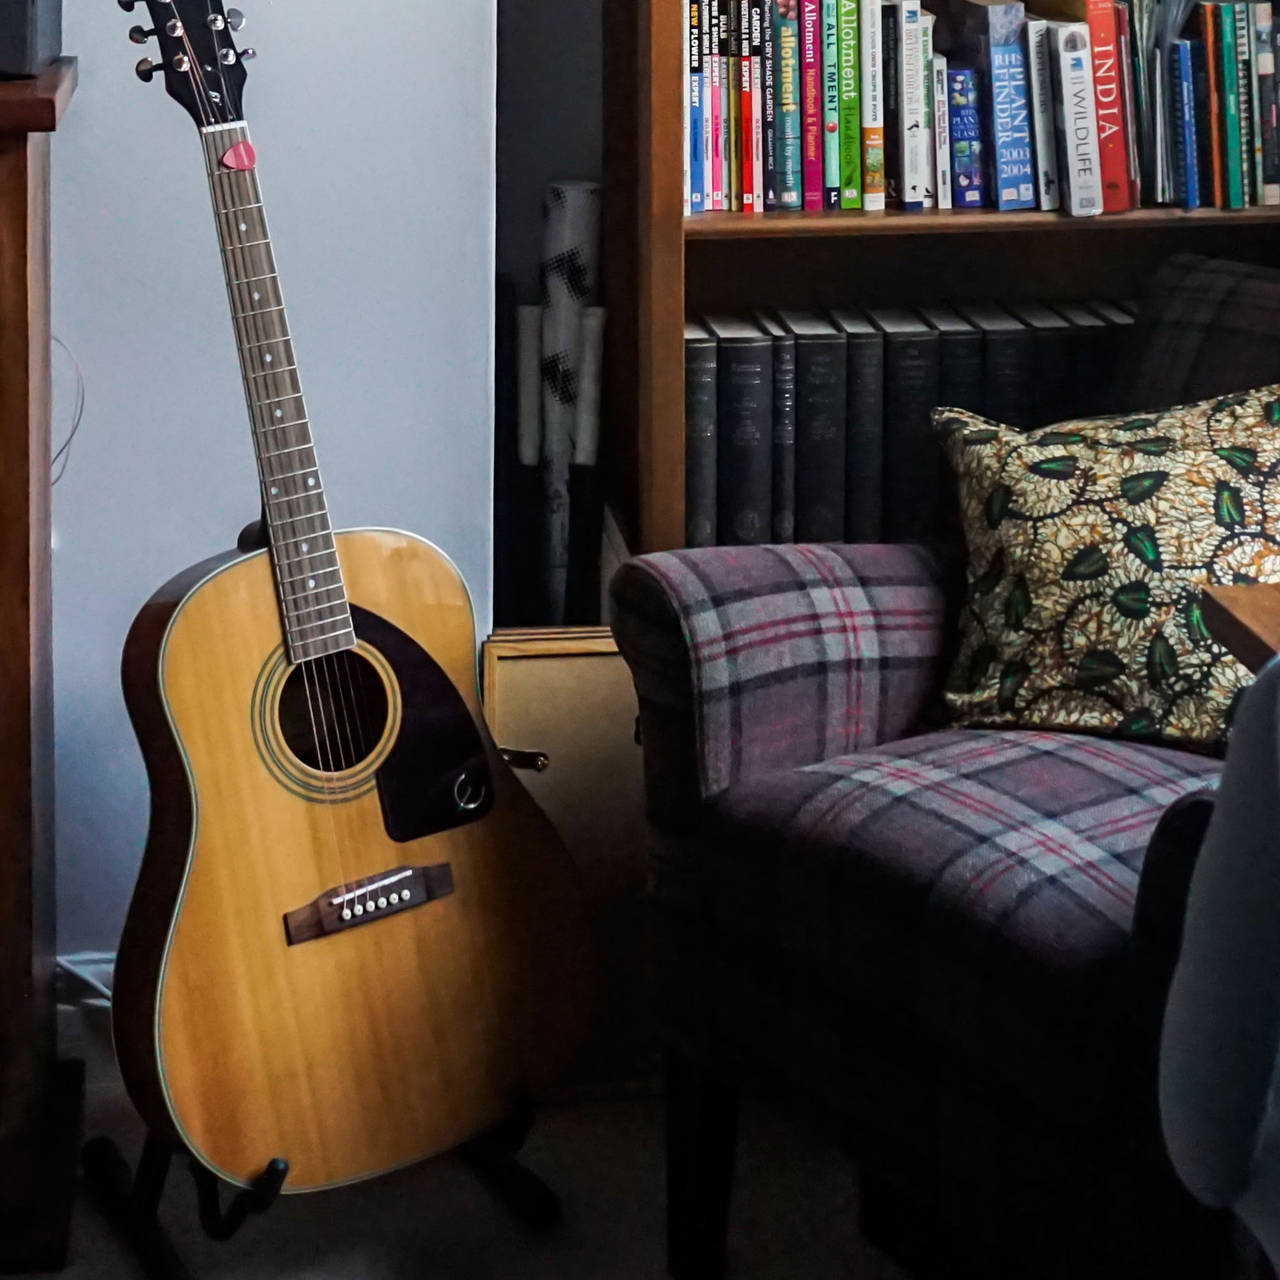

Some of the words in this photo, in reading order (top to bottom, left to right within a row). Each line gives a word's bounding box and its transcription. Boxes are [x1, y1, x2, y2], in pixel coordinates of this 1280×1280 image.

[720, 14, 728, 39] BULB
[741, 0, 750, 33] VEGETABLE
[752, 7, 761, 46] GARDEN
[763, 0, 772, 28] Planting
[691, 28, 699, 68] FLOWER
[805, 1, 817, 63] Allotment
[741, 40, 749, 57] HERB
[765, 41, 773, 58] DRY
[993, 53, 1023, 66] RHS
[742, 61, 750, 92] EXPERT
[765, 59, 773, 87] SHADE
[781, 26, 797, 113] allotment
[691, 76, 699, 108] EXPERT
[766, 88, 774, 122] GARDEN
[806, 68, 817, 115] Handbook
[995, 68, 1012, 145] FINDER
[1009, 67, 1030, 143] PLANT
[1093, 43, 1120, 140] INDIA
[785, 116, 795, 144] month
[807, 125, 818, 161] Planner
[1072, 88, 1093, 178] WILDLIFE
[784, 146, 794, 157] by
[1000, 147, 1030, 162] 2003
[785, 159, 796, 187] month
[1000, 163, 1031, 178] 2004
